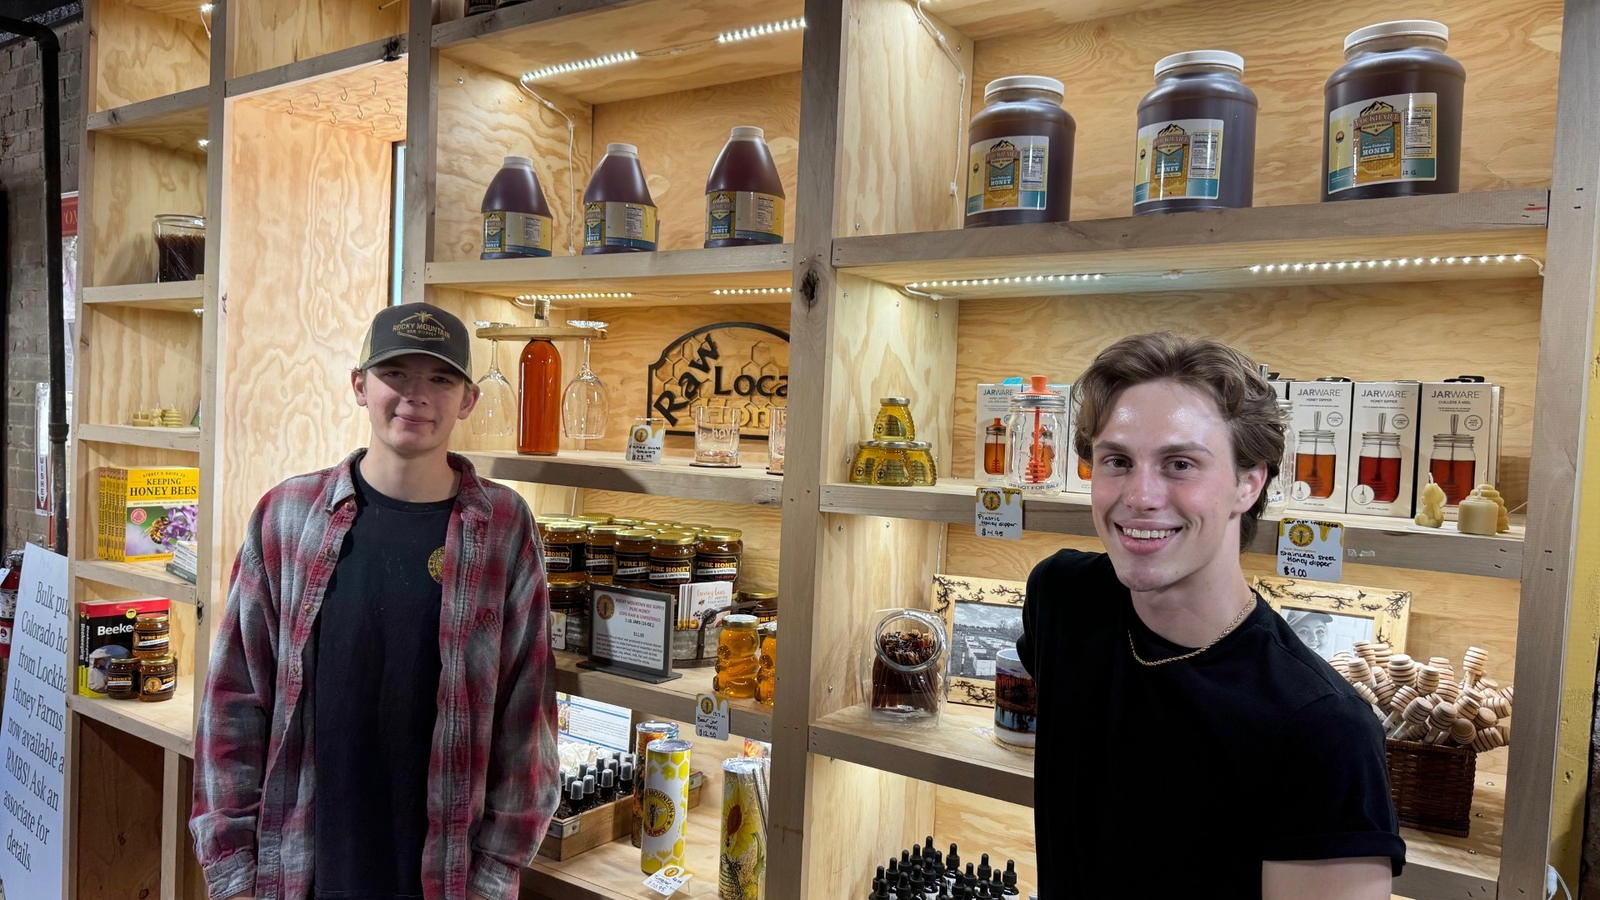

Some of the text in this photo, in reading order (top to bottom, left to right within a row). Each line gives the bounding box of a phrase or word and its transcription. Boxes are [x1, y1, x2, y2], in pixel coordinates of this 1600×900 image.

[1354, 113, 1399, 127] LOCKHART
[1362, 146, 1391, 156] HONEY
[392, 322, 451, 339] ROCKY MOUNTAIN
[653, 332, 720, 427] Raw
[1298, 388, 1341, 396] JARWARE
[1361, 390, 1407, 398] JARWARE
[1431, 390, 1480, 398] JARWARE
[146, 478, 182, 486] KEEPING
[130, 486, 197, 496] HONEY BEES
[978, 514, 1000, 522] Plastic
[982, 528, 1004, 536] $4.95
[1308, 560, 1332, 568] dipper
[1284, 566, 1308, 578] $9.00
[36, 581, 54, 610] Bulk
[21, 610, 55, 649] Colorado
[18, 645, 35, 676] from
[12, 678, 64, 732] Honey Farms
[7, 716, 22, 742] now
[22, 730, 58, 769] available
[5, 746, 58, 812] RMBS! Ask an
[3, 790, 50, 846] associate for
[6, 828, 32, 873] details.
